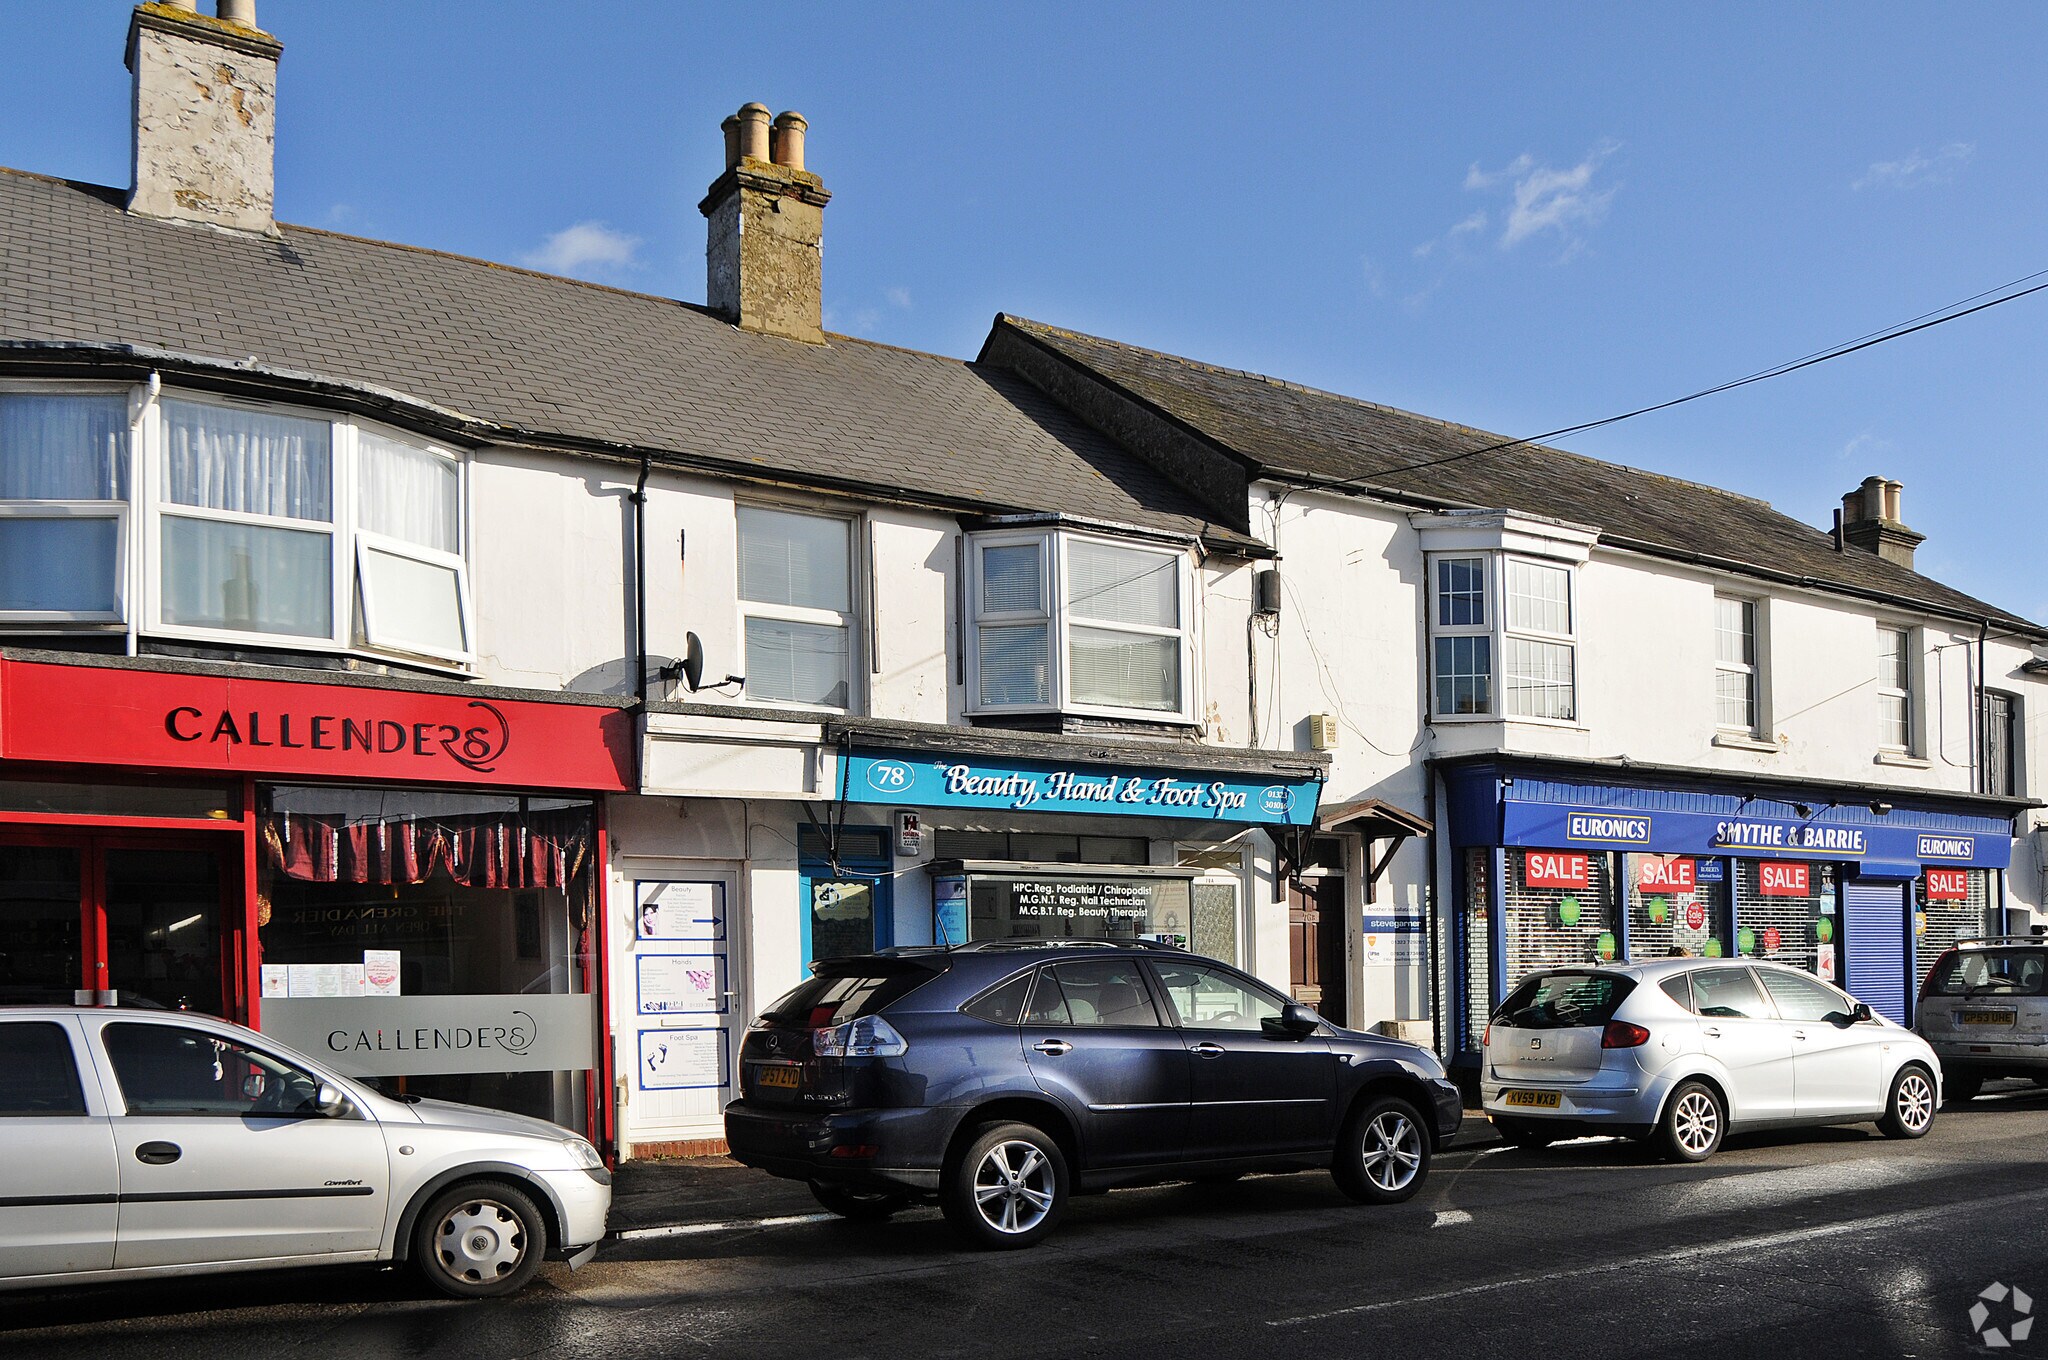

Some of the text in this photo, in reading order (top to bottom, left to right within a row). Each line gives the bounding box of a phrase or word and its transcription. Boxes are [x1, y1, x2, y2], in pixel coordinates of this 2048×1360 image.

[165, 692, 510, 773] CALLENDERS
[877, 765, 905, 786] 78
[933, 761, 1247, 818] The Beauty, Hand & Foot Spa
[1267, 790, 1288, 799] 01323
[1264, 800, 1288, 810] 301016
[1572, 817, 1646, 839] EURONICS
[1716, 821, 1863, 850] SMYTHE & BARRIE
[1920, 838, 1971, 857] EURONICS
[1530, 855, 1584, 880] SALE
[1642, 863, 1691, 885] SALE
[1763, 867, 1806, 889] SALE
[1929, 873, 1965, 893] SALE
[1056, 884, 1097, 895] Podiatrist
[1104, 885, 1152, 897] Chiropodist
[1019, 896, 1058, 906] M.G.N.T.
[1059, 896, 1079, 907] Reg.
[1081, 896, 1099, 906] Nail
[1099, 897, 1146, 907] Technician
[1018, 906, 1148, 919] M.G.B.T. Reg. Beauty Therapist
[1688, 909, 1703, 919] Sale
[1370, 920, 1422, 929] stevegarner
[326, 1010, 538, 1056] CALLENDERS
[685, 1034, 698, 1042] Spa
